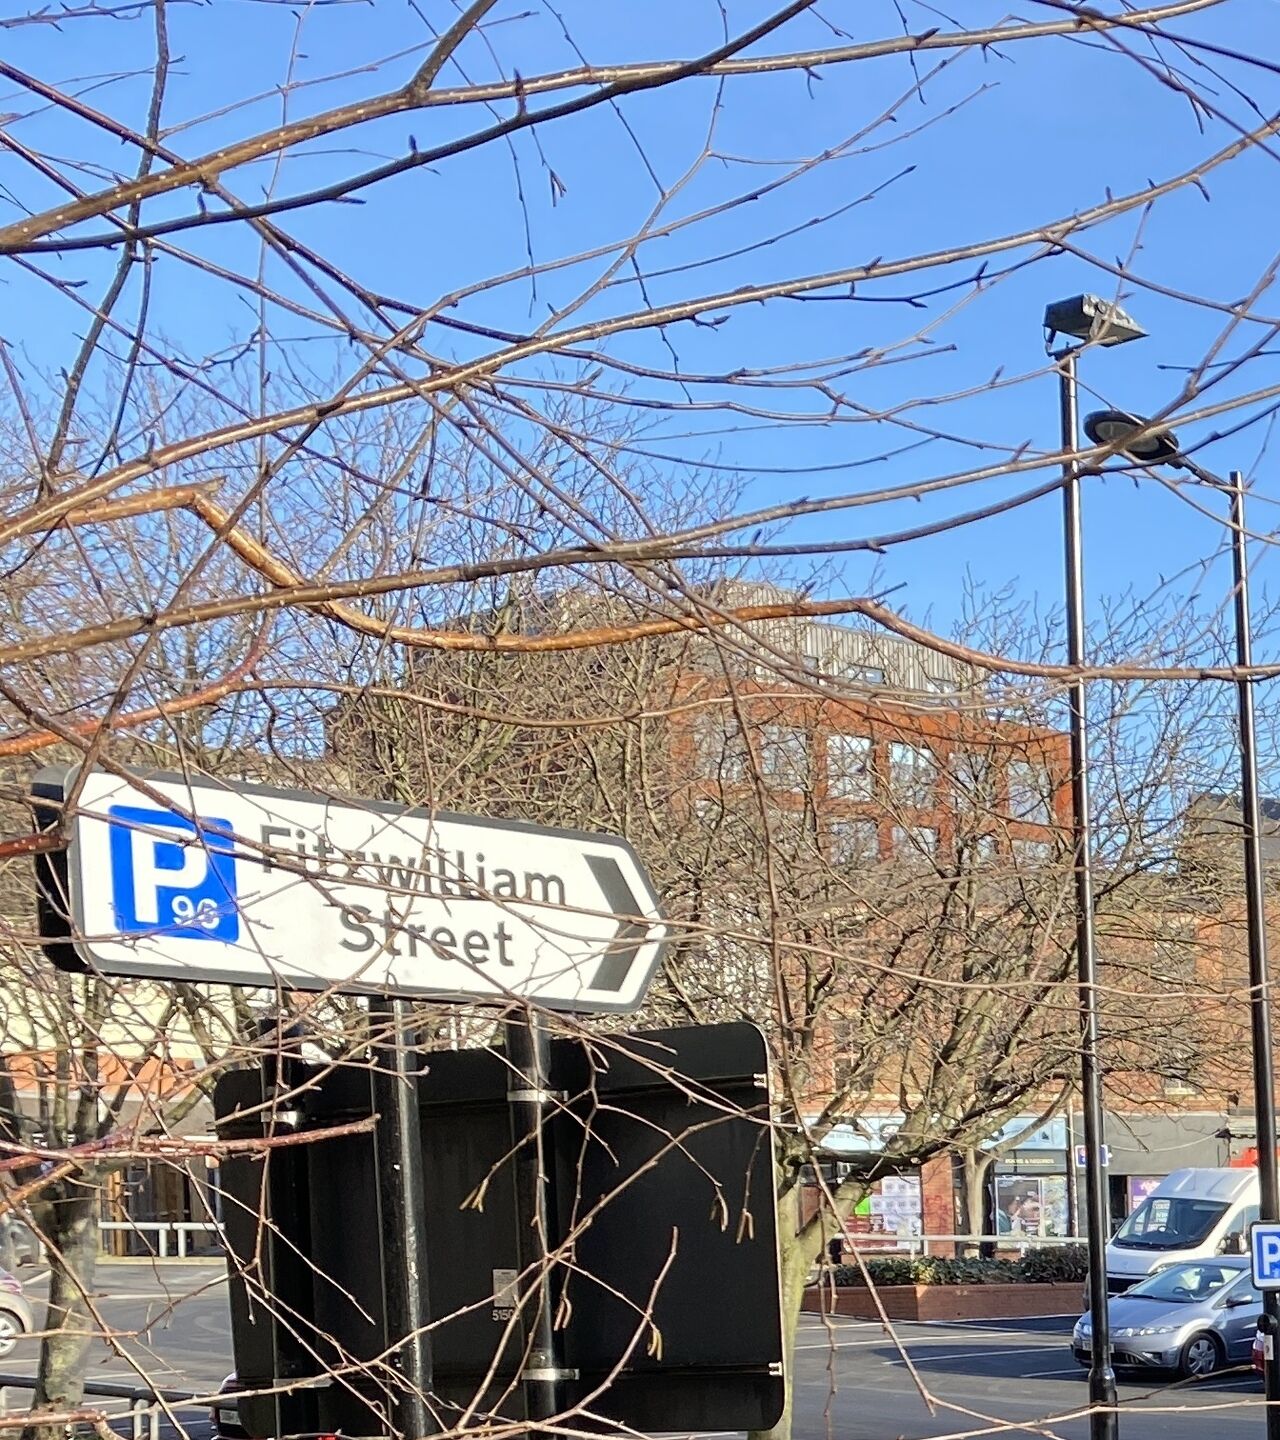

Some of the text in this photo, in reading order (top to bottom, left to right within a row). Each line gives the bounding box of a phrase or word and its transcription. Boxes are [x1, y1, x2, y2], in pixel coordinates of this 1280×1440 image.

[130, 821, 208, 923] P
[260, 824, 566, 907] Fitzwilliam
[338, 903, 515, 967] Street
